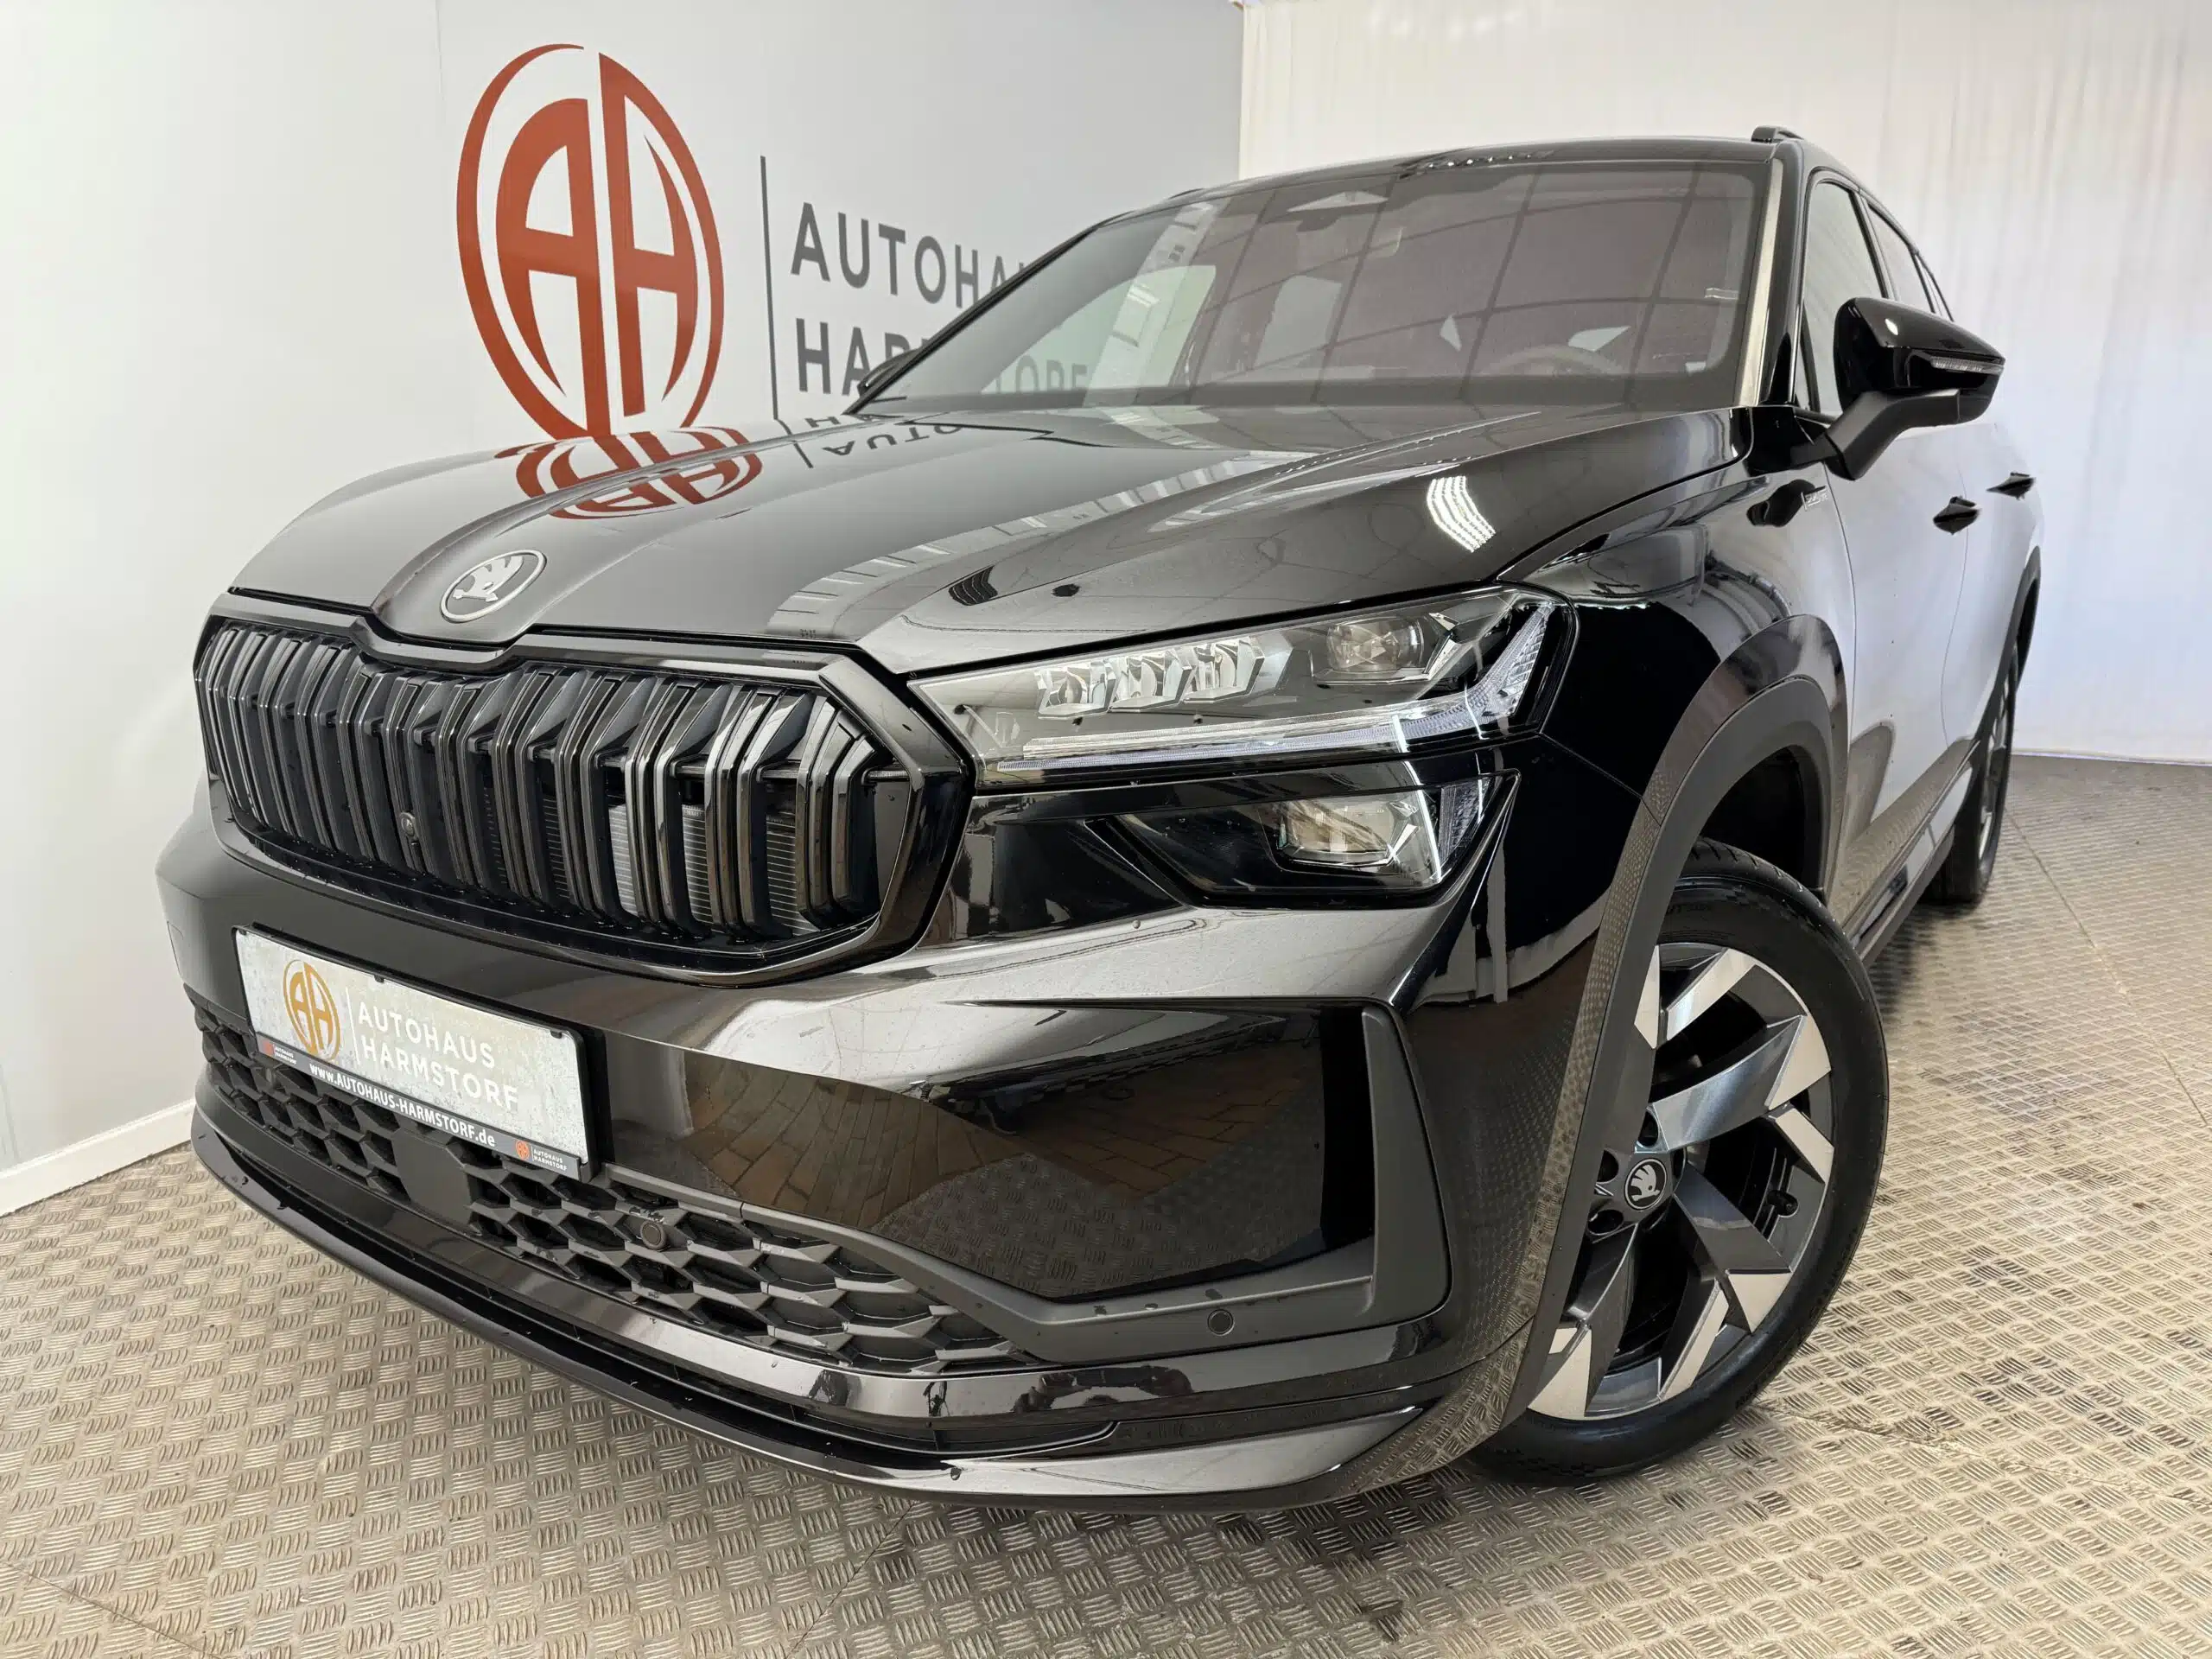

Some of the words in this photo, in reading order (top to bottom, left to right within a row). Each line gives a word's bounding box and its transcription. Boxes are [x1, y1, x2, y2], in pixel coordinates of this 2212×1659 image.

[359, 1002, 495, 1069] AUTOHAUS
[362, 1035, 518, 1110] HARMSTORF
[309, 1063, 495, 1147] www.AUTOHAUS-HARMSTORF.de
